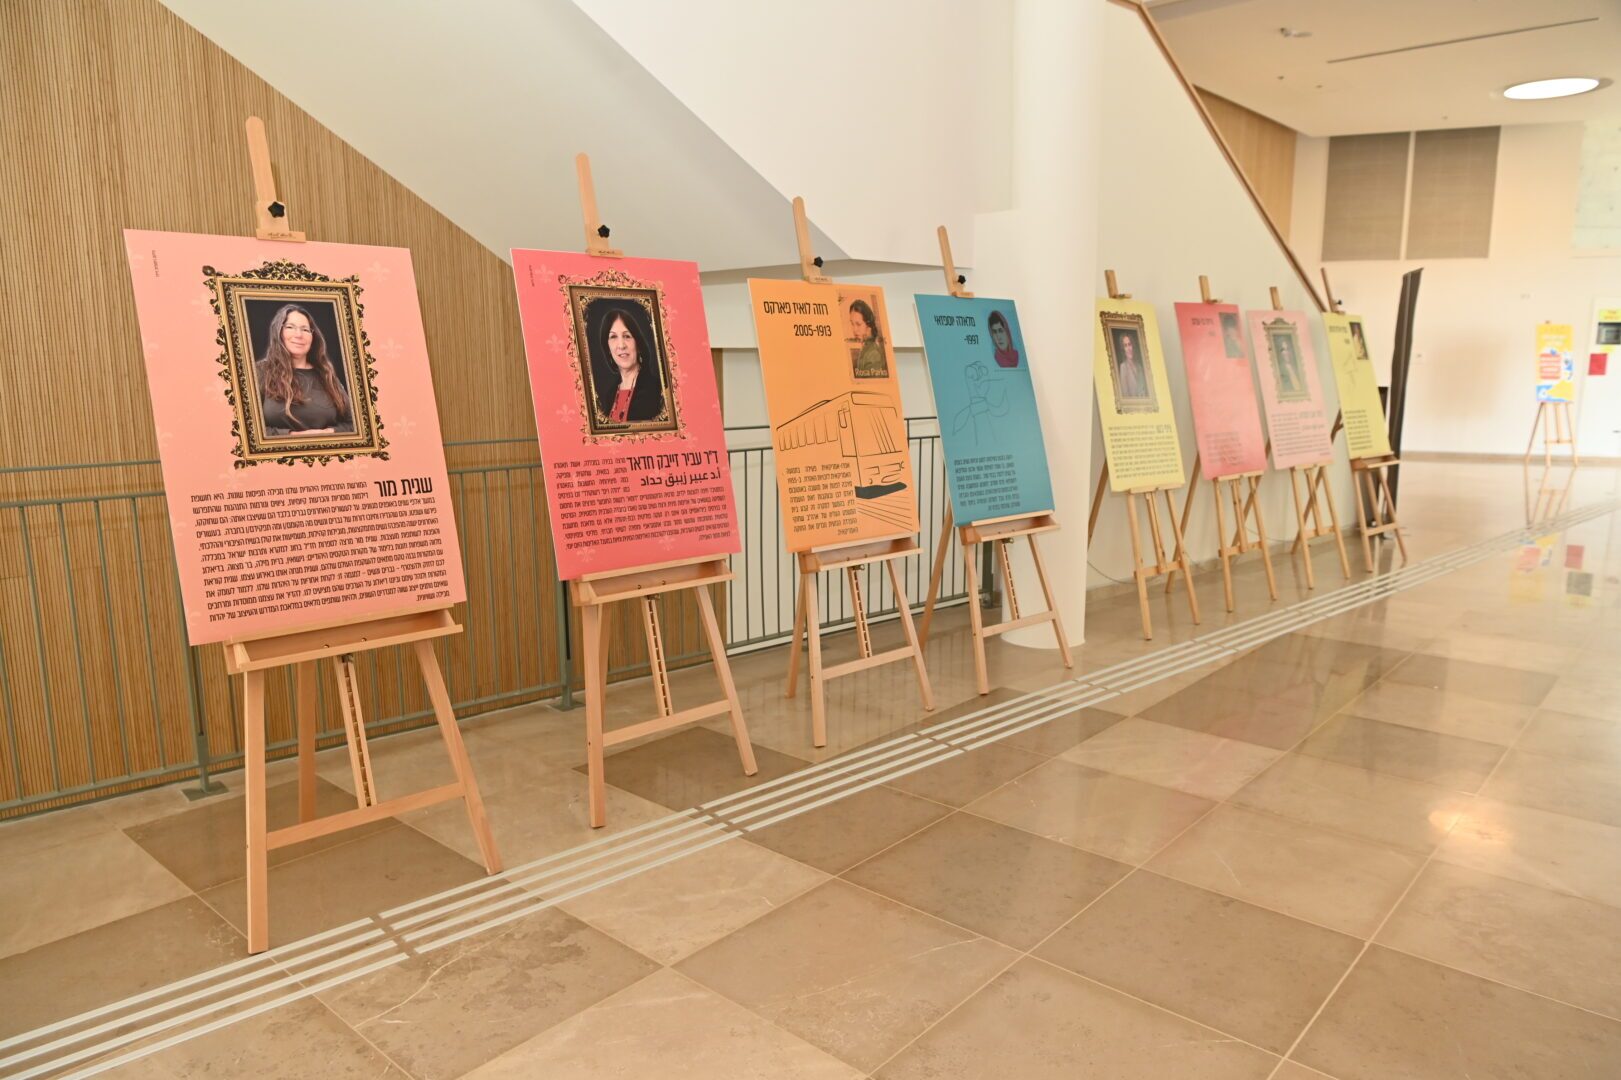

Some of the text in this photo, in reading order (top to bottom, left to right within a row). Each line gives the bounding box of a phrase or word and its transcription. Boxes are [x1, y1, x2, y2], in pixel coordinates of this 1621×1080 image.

[763, 301, 829, 315] רוזה לואיז פארקס
[855, 368, 888, 376] Rosa Parks
[656, 454, 679, 470] זייבק
[681, 452, 702, 466] עביר
[627, 456, 655, 471] חדאד
[640, 475, 662, 487] حداد
[666, 472, 688, 488] زيبق
[689, 472, 709, 484] عبير
[374, 477, 432, 497] שגית מור
[213, 492, 224, 500] היא
[267, 511, 276, 519] הם
[219, 516, 228, 524] הם
[245, 561, 252, 569] בר
[291, 578, 299, 586] על
[364, 579, 371, 587] על
[205, 589, 215, 598] את
[275, 592, 284, 600] את
[226, 611, 236, 619] של
